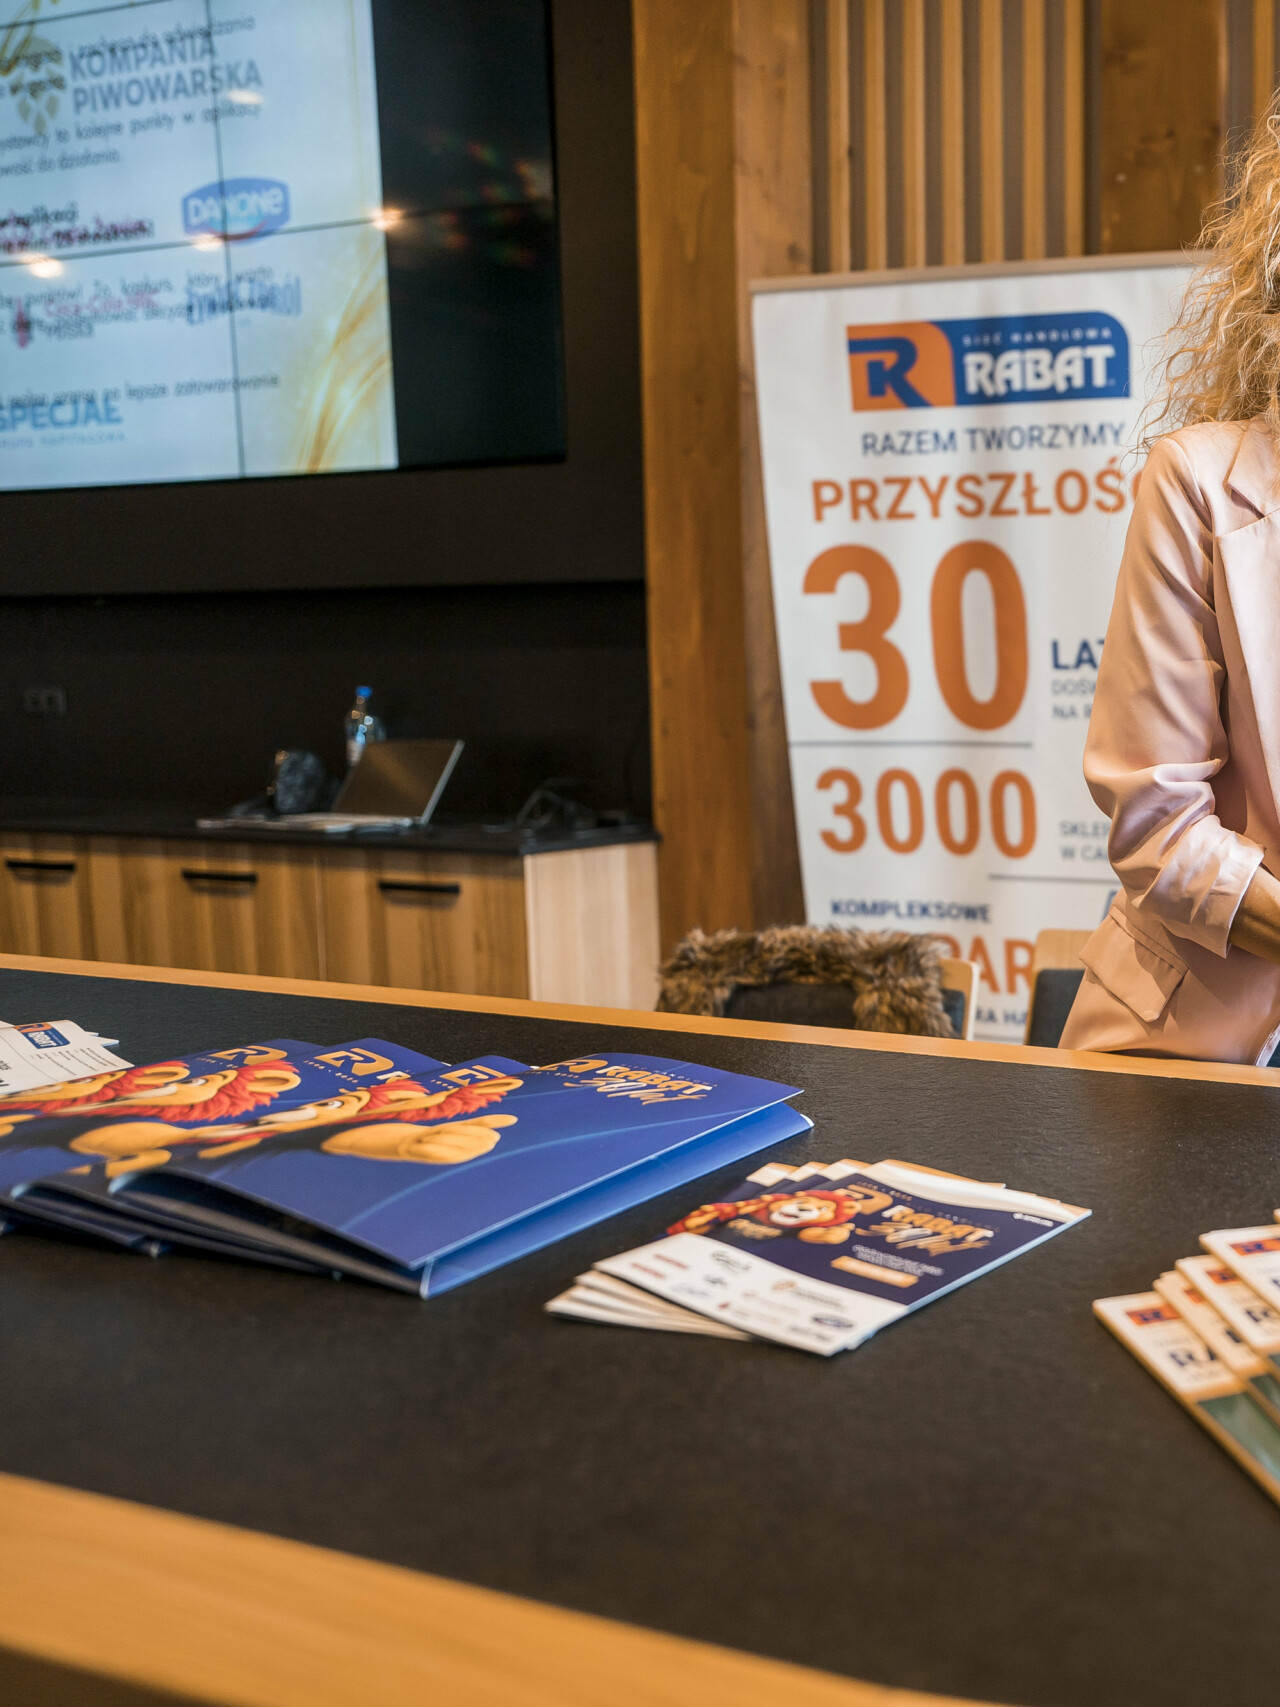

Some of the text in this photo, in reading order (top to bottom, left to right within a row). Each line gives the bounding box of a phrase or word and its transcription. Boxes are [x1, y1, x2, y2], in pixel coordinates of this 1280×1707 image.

[68, 37, 216, 81] KOMPANIA
[73, 60, 264, 114] PIWOWARSKA
[963, 345, 1116, 397] RABAT
[862, 422, 1125, 457] RAZEM TWORZYMY
[812, 457, 1140, 523] PRZYSZŁOŚ
[803, 539, 1029, 732] 30
[816, 767, 1037, 859] 3000
[831, 899, 992, 924] KOMPLEKSOWE
[595, 1065, 713, 1095] RABAT
